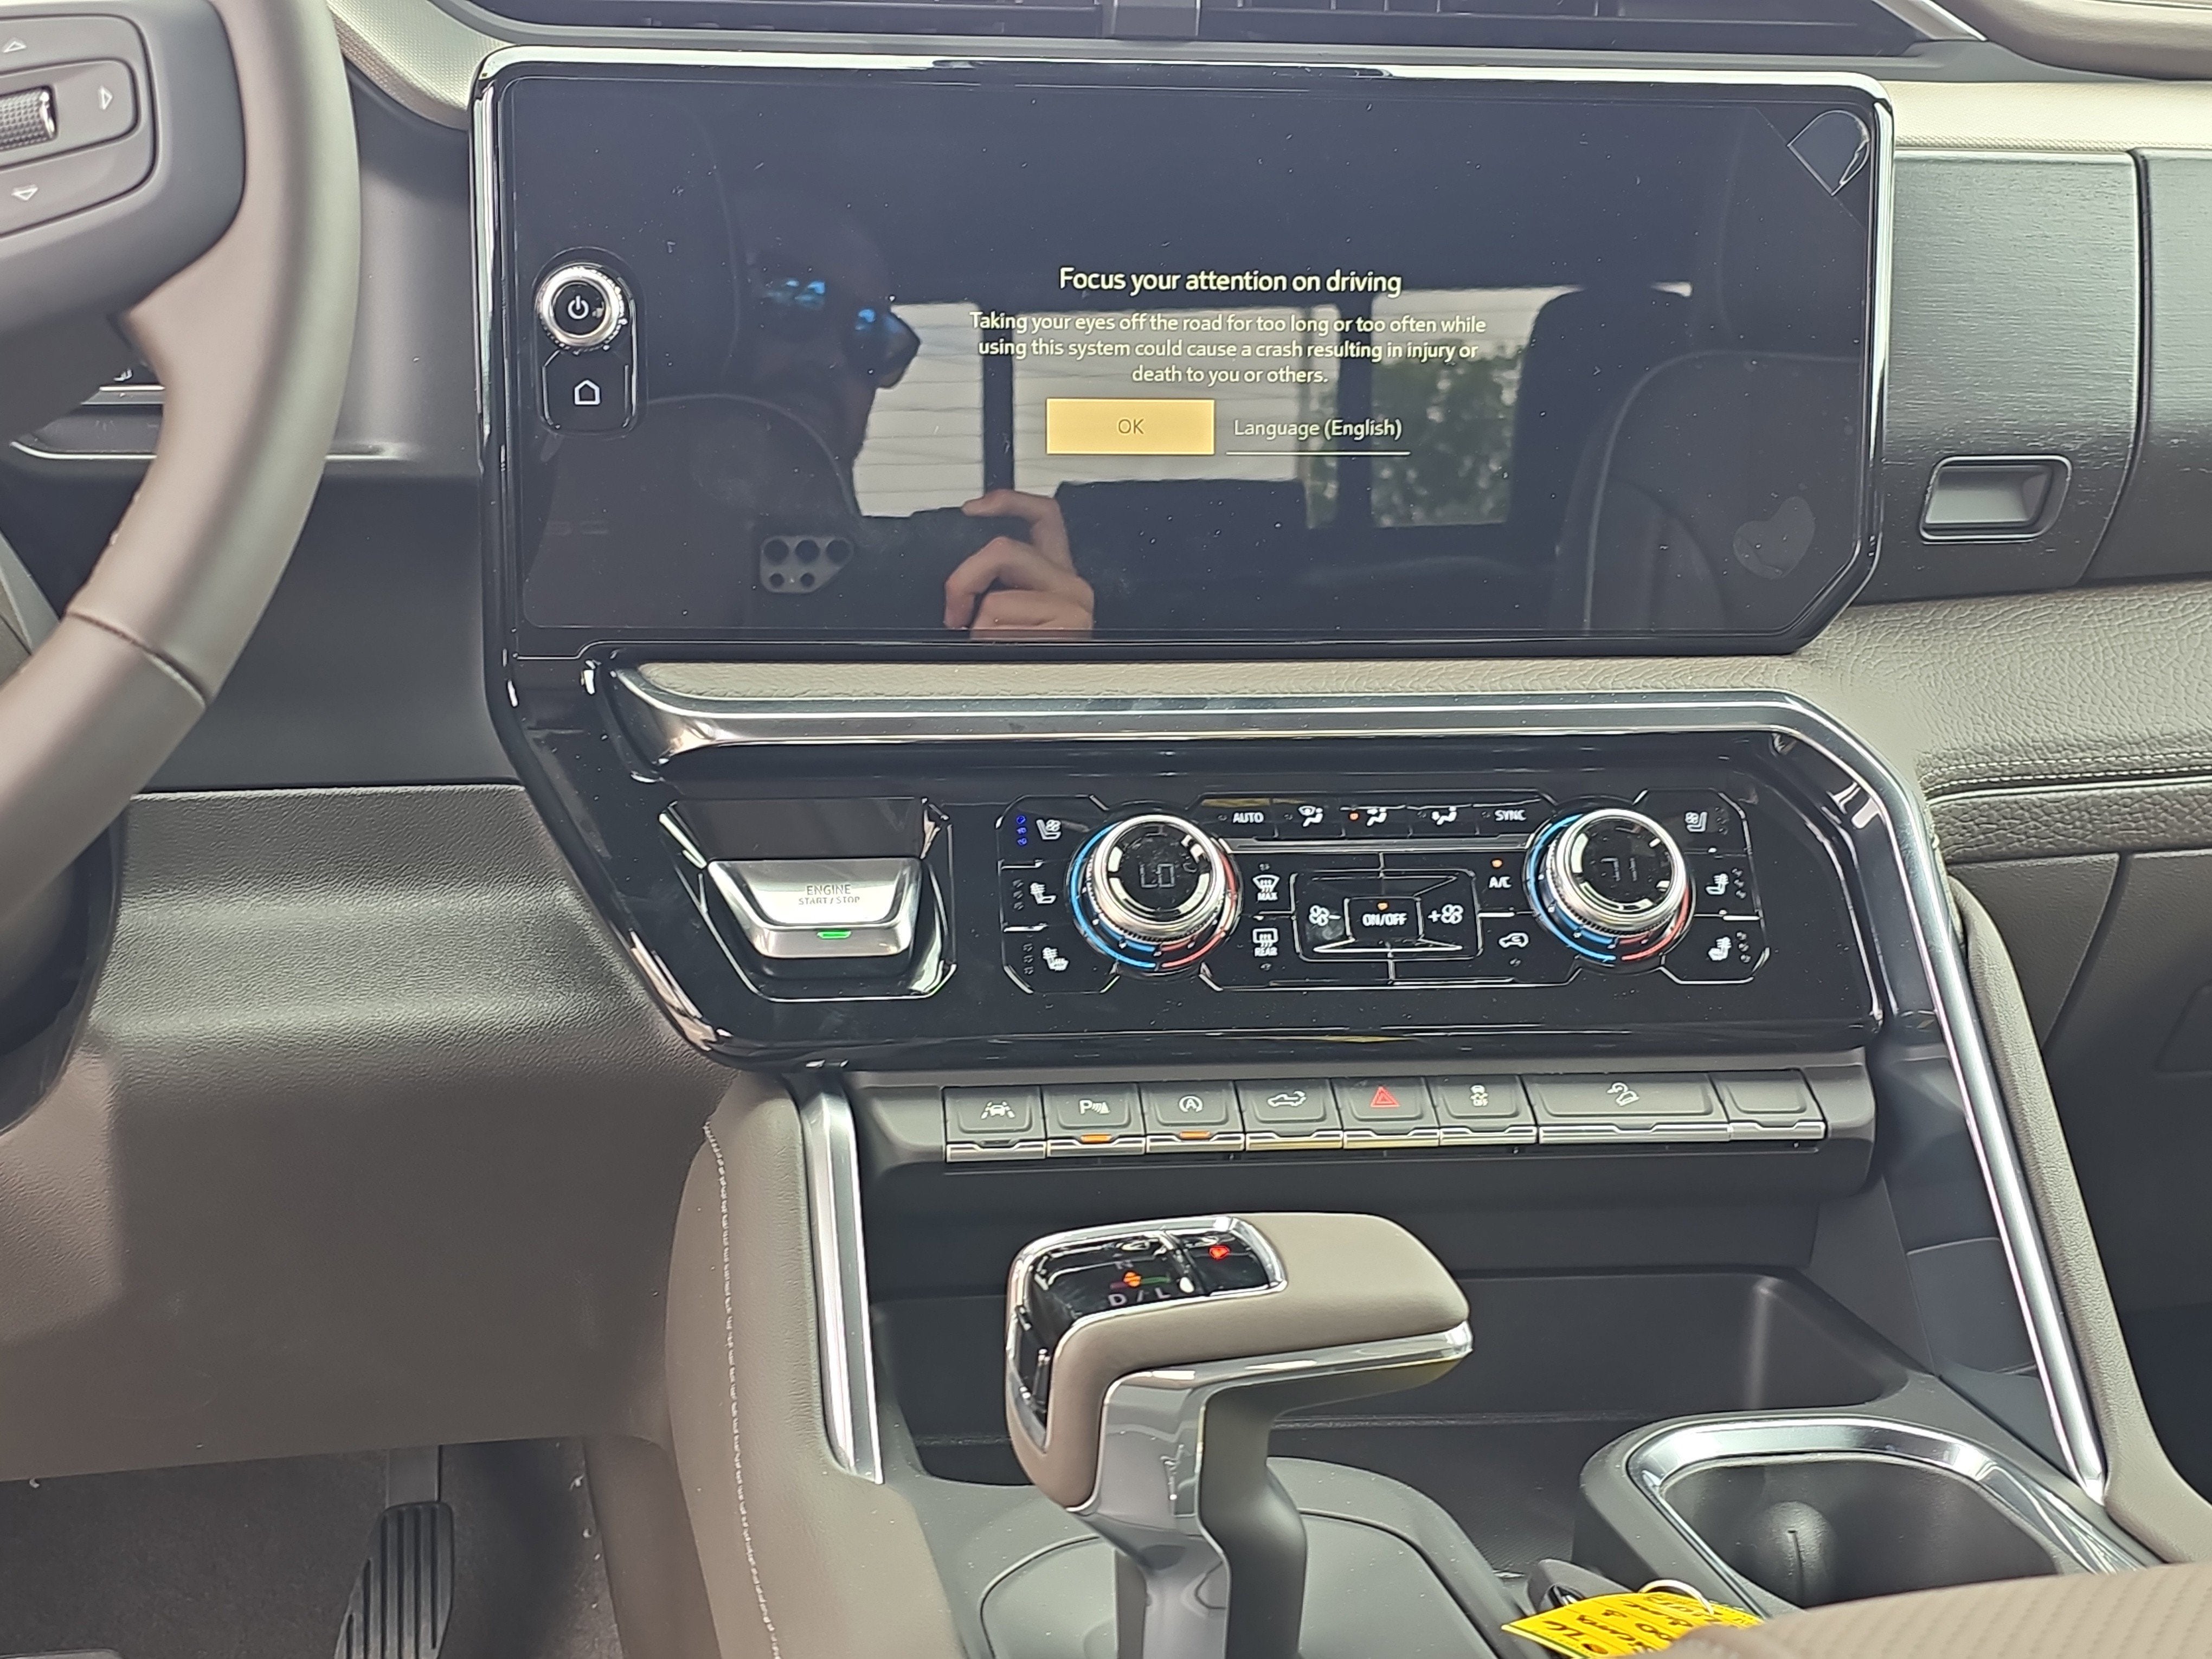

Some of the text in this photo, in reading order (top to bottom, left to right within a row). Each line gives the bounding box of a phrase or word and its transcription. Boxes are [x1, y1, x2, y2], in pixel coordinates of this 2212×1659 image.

[1059, 267, 1403, 298] Focus your attention on driving
[969, 311, 1486, 336] Taking your eyes off the road for too long or too often while
[978, 337, 1479, 363] using this system could cause a crash resulting in injury or
[1131, 364, 1329, 388] death to you or others.
[1117, 418, 1144, 435] OK
[1234, 418, 1403, 441] Language (English)
[1232, 812, 1264, 824] AUTO
[1494, 809, 1527, 821] SYNC
[806, 884, 851, 895] ENGINE
[1489, 876, 1512, 889] A/C
[1362, 912, 1408, 927] ON/OFF
